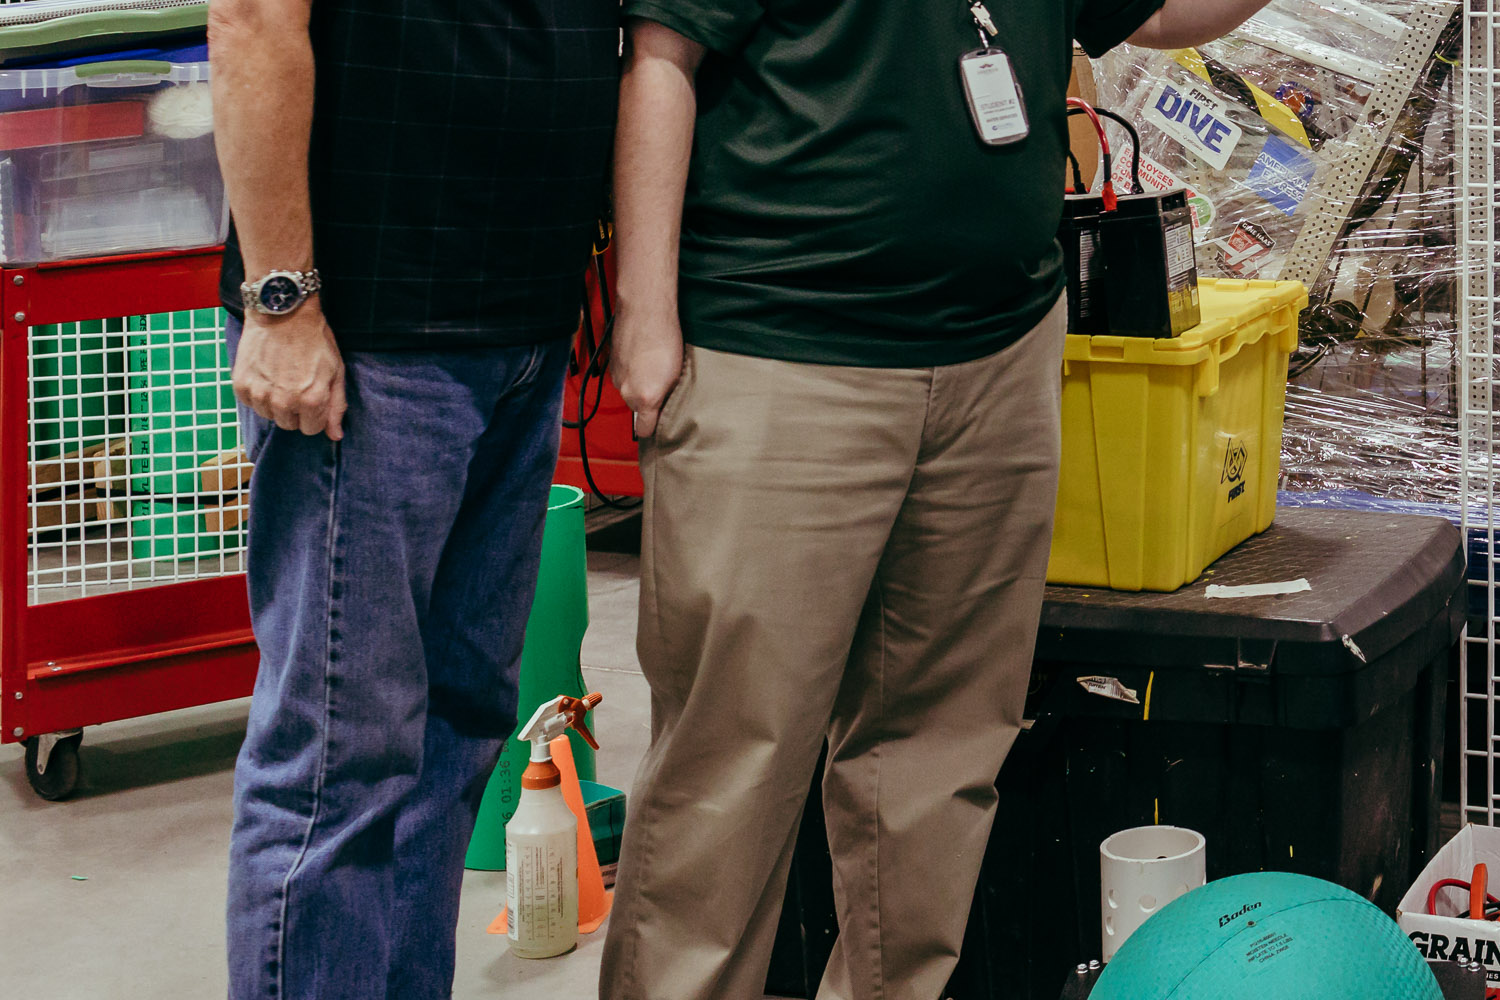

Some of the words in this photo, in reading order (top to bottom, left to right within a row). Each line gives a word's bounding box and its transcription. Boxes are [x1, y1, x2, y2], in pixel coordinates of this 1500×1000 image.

[1188, 87, 1220, 111] FIRST
[1154, 84, 1232, 154] DIVE
[1115, 164, 1133, 180] FUN
[1119, 156, 1169, 191] COMUNIT
[1255, 232, 1273, 247] HAAS
[1218, 901, 1262, 929] Baden
